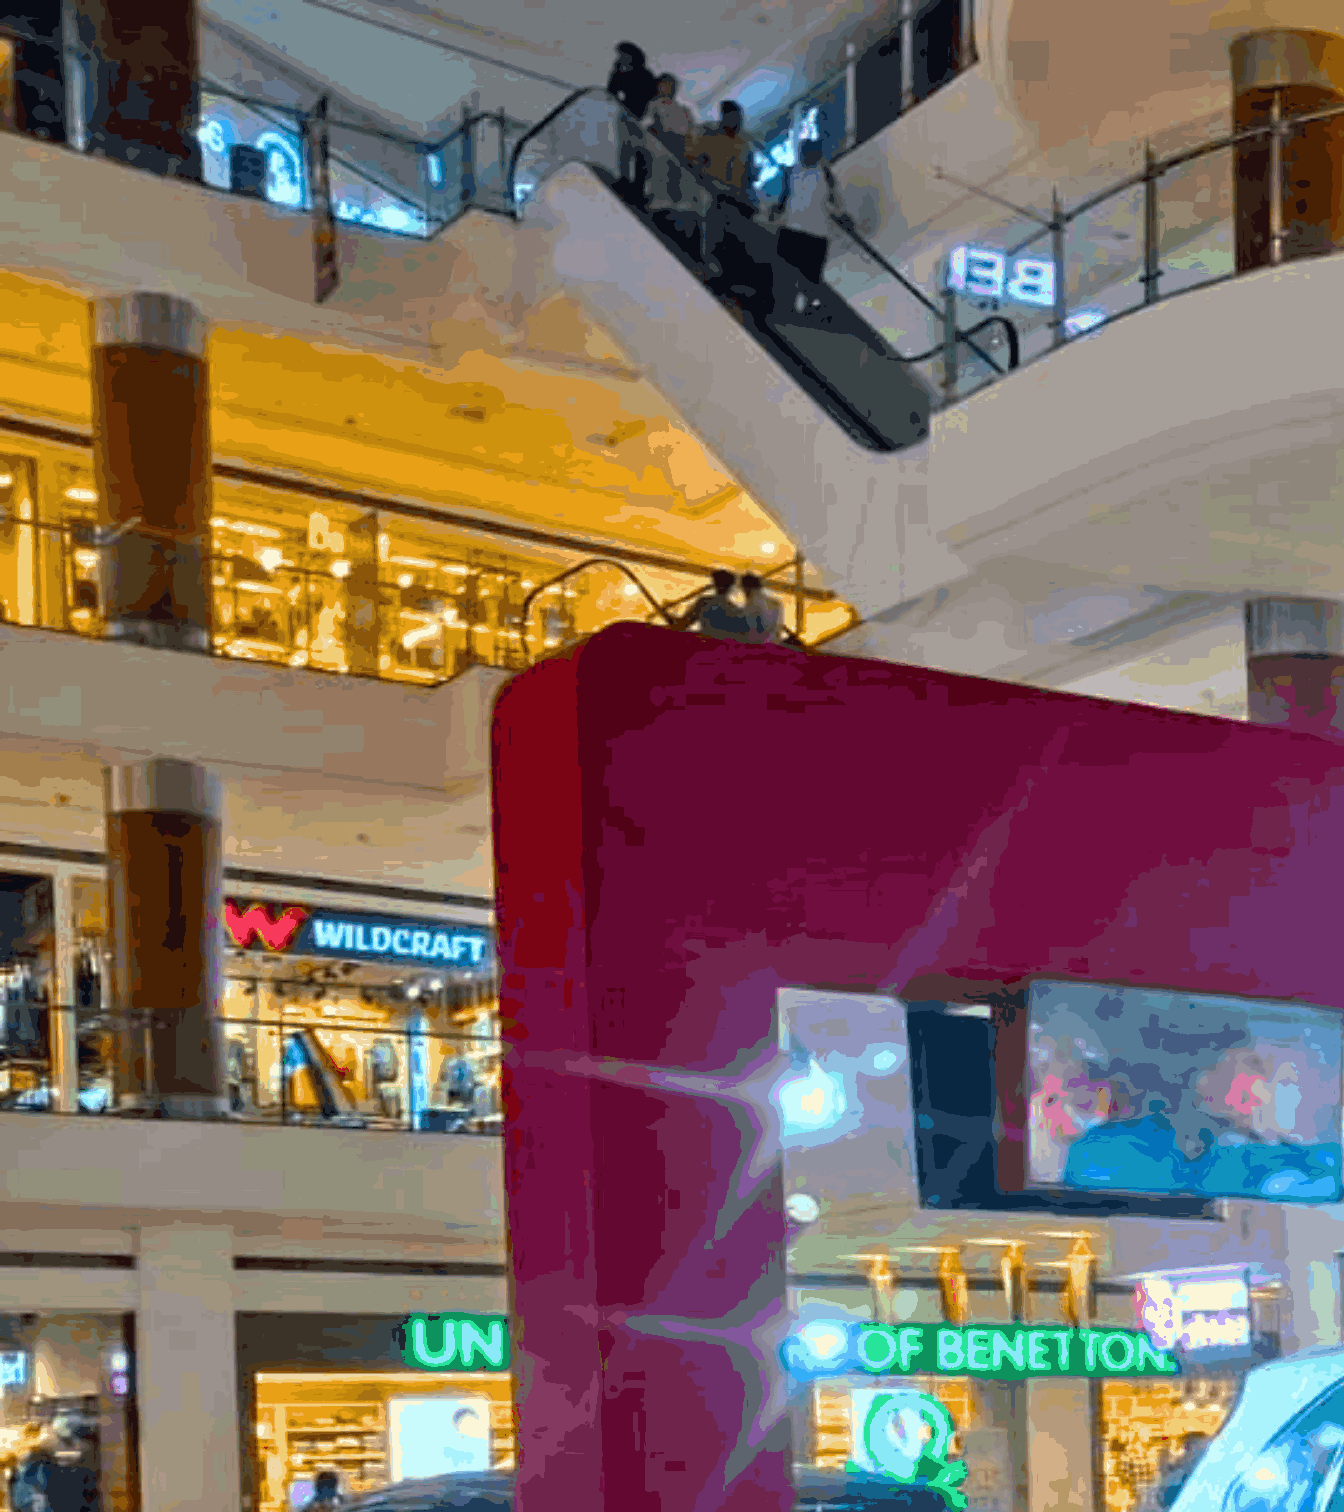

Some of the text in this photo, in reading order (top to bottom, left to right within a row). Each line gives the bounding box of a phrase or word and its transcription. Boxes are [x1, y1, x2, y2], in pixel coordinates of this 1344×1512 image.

[313, 919, 486, 962] WILDCRAFT
[411, 1319, 1174, 1373] UN OF BENETTON
